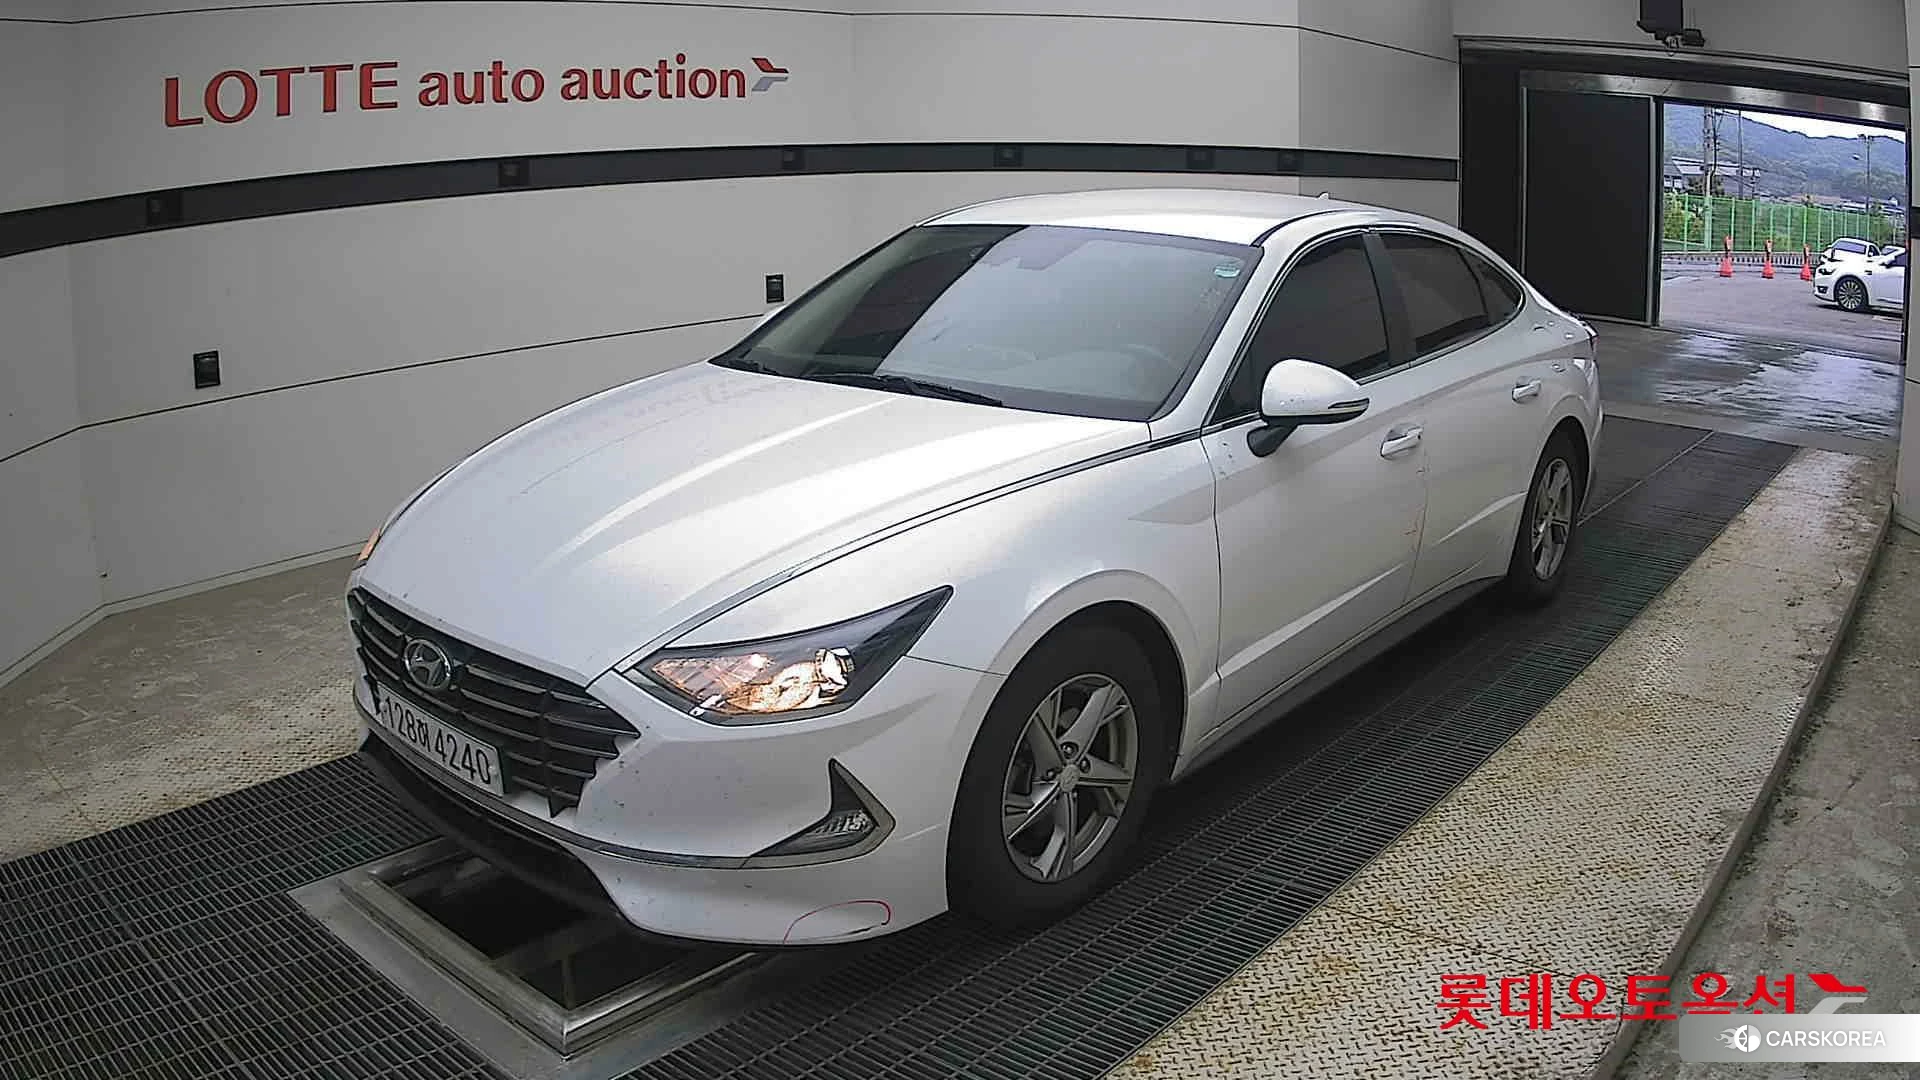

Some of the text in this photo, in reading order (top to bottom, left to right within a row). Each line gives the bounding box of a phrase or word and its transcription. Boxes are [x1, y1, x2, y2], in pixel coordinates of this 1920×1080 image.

[164, 53, 747, 127] LOTTE auto auction
